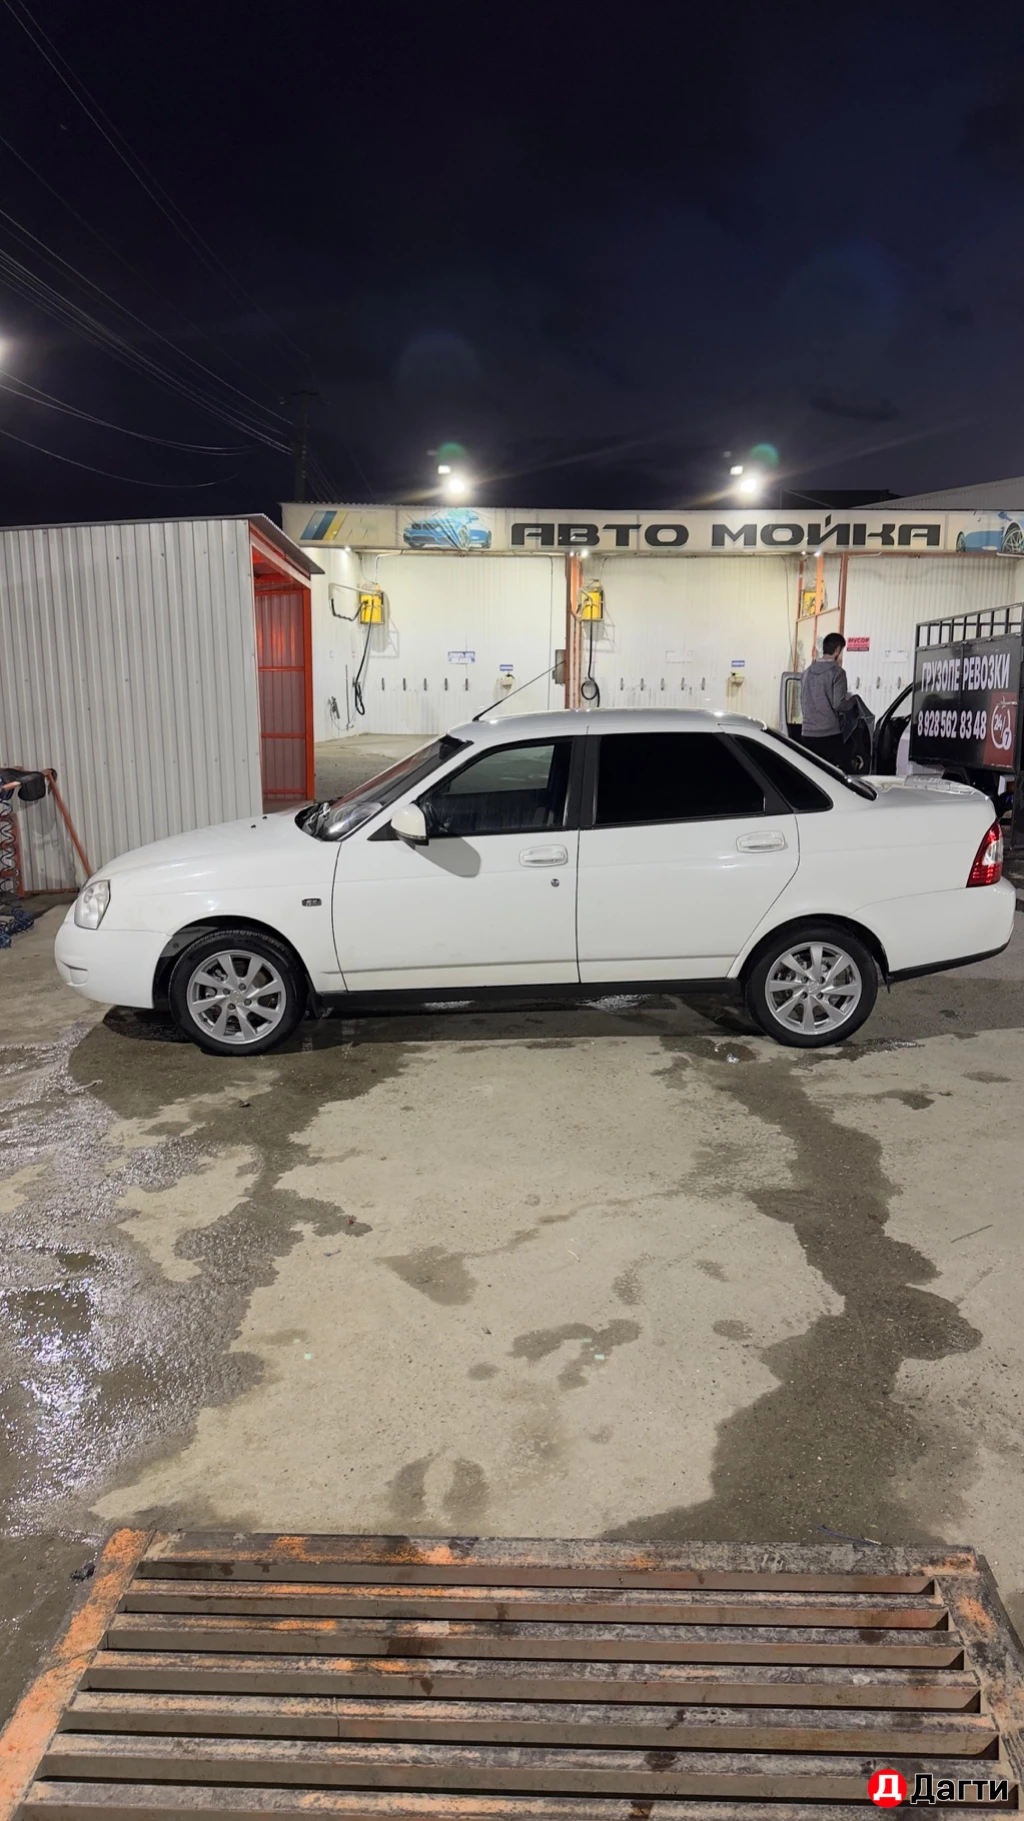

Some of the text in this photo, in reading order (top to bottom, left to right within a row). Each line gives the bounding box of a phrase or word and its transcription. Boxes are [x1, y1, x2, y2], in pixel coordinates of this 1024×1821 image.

[511, 514, 941, 547] АВТО МОЙКА
[923, 710, 940, 737] 928
[940, 710, 958, 738] 562
[959, 710, 973, 739] 83
[973, 710, 987, 740] 48
